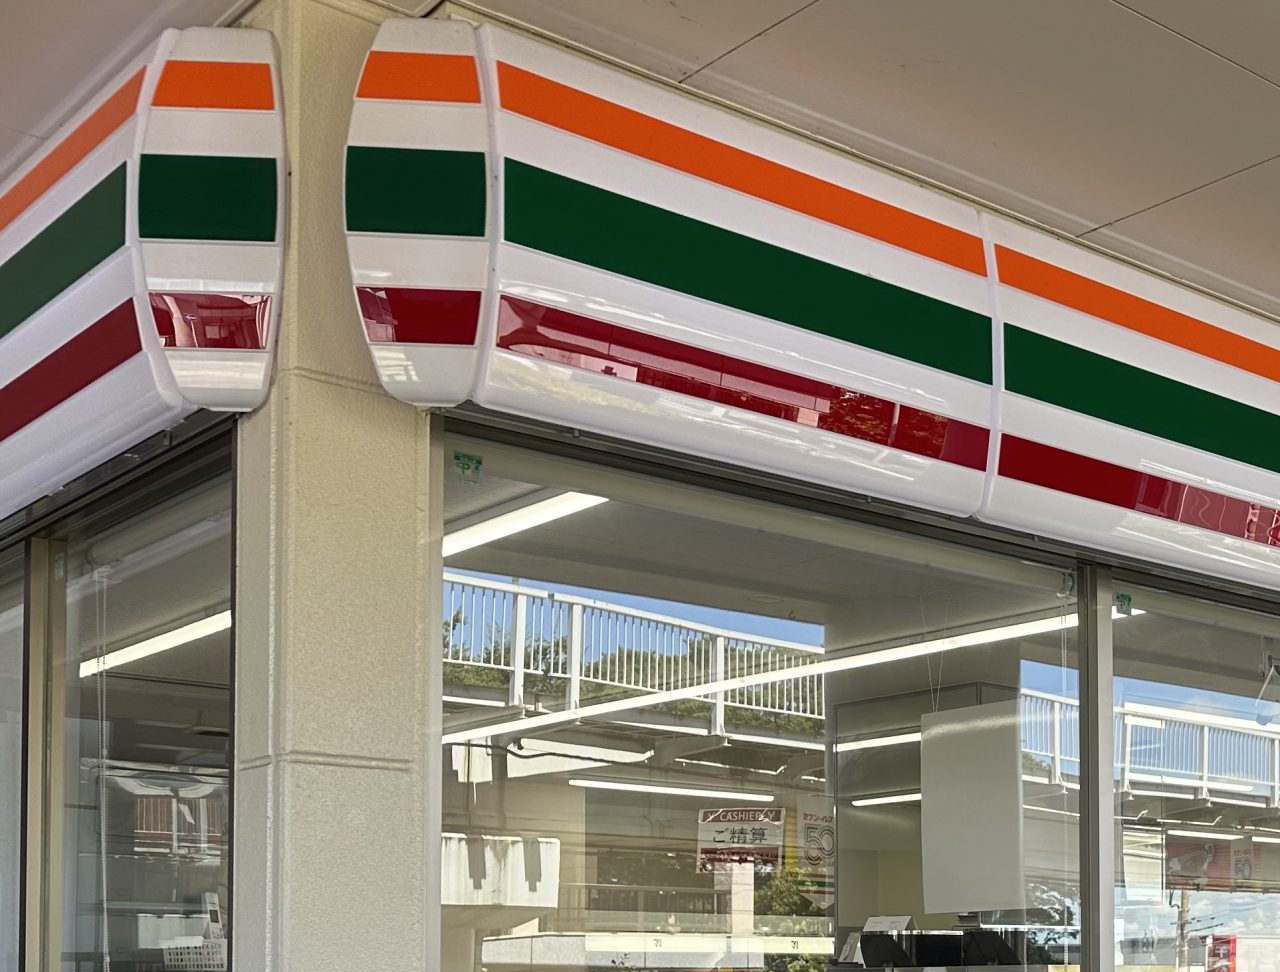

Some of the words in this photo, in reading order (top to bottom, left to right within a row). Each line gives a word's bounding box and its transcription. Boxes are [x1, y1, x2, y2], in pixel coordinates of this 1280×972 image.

[720, 811, 762, 822] CASHIER
[713, 827, 768, 844] ご精算
